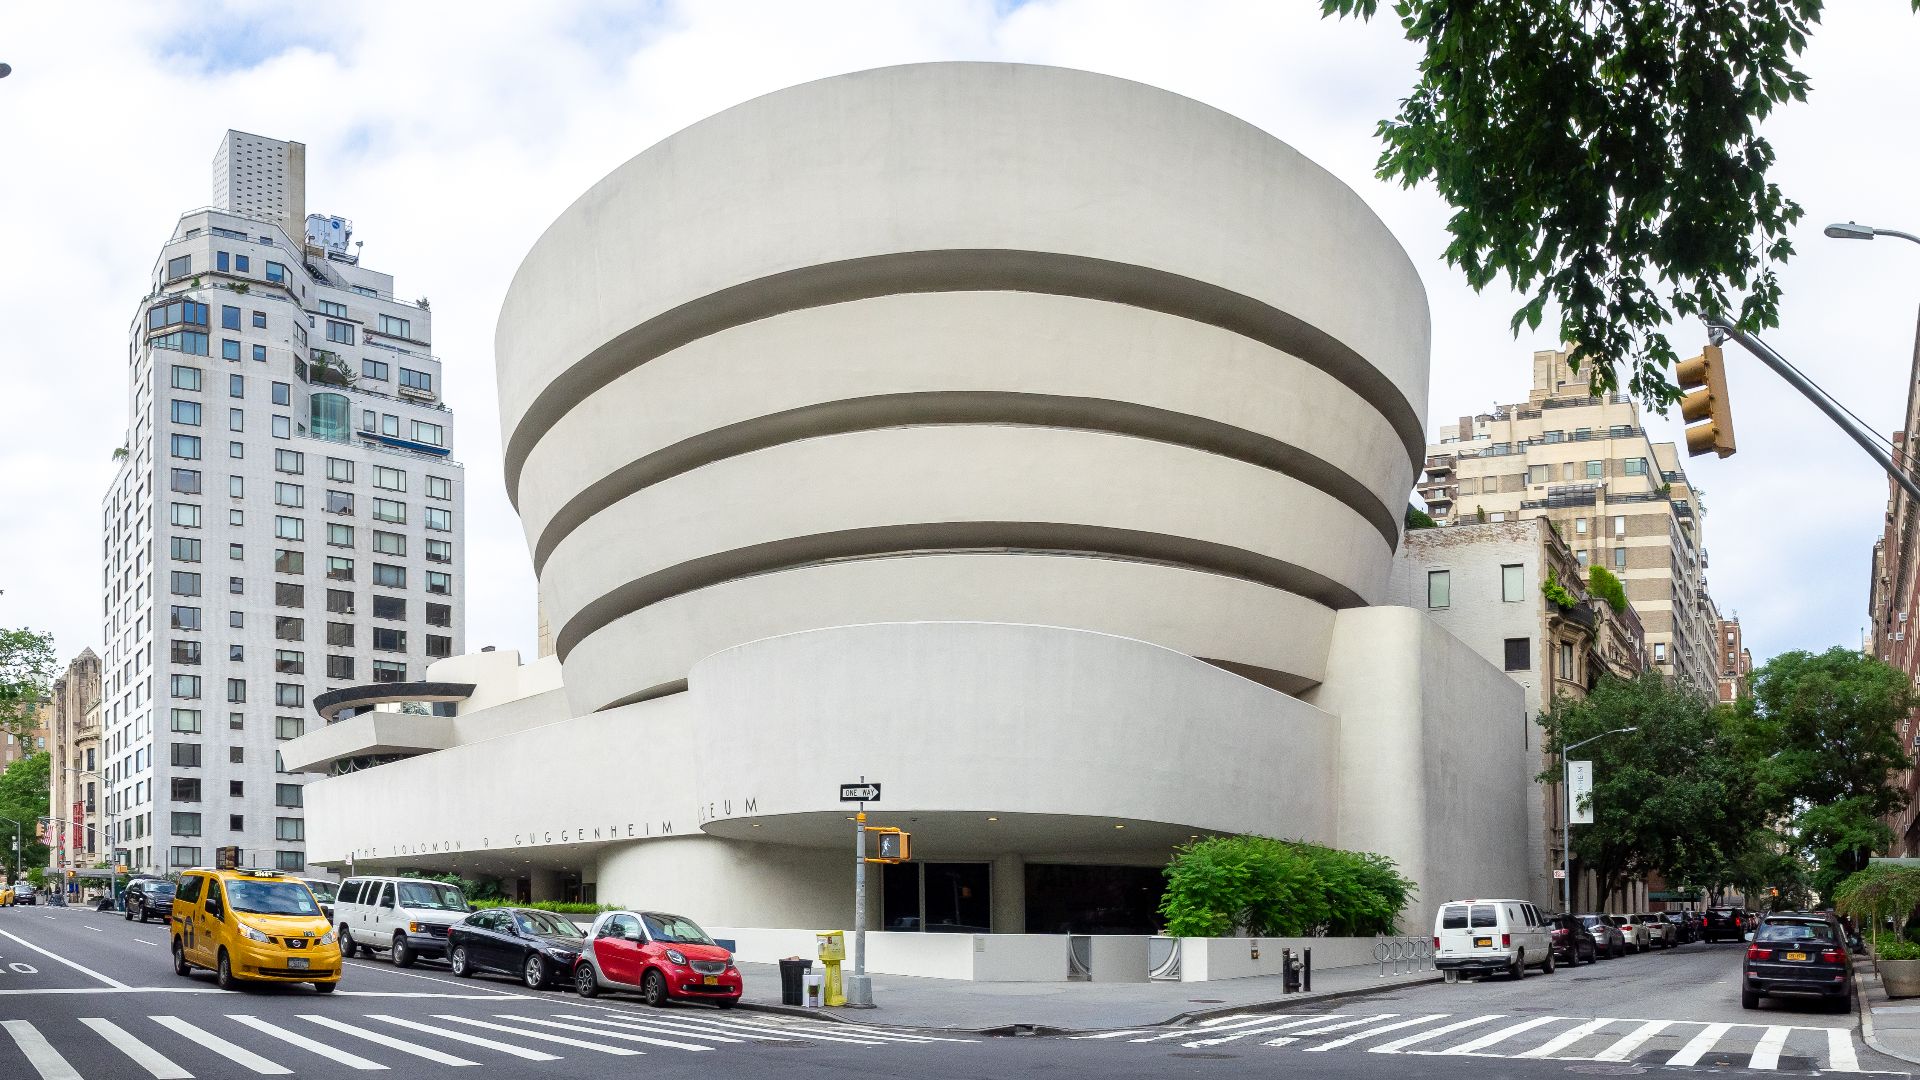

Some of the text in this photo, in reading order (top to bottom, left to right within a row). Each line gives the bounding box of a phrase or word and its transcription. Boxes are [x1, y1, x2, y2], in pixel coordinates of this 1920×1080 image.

[845, 788, 875, 797] ONE WAY
[393, 840, 461, 855] SOLOMON
[514, 819, 673, 846] GUGGENHEIM
[698, 797, 758, 822] SEUM
